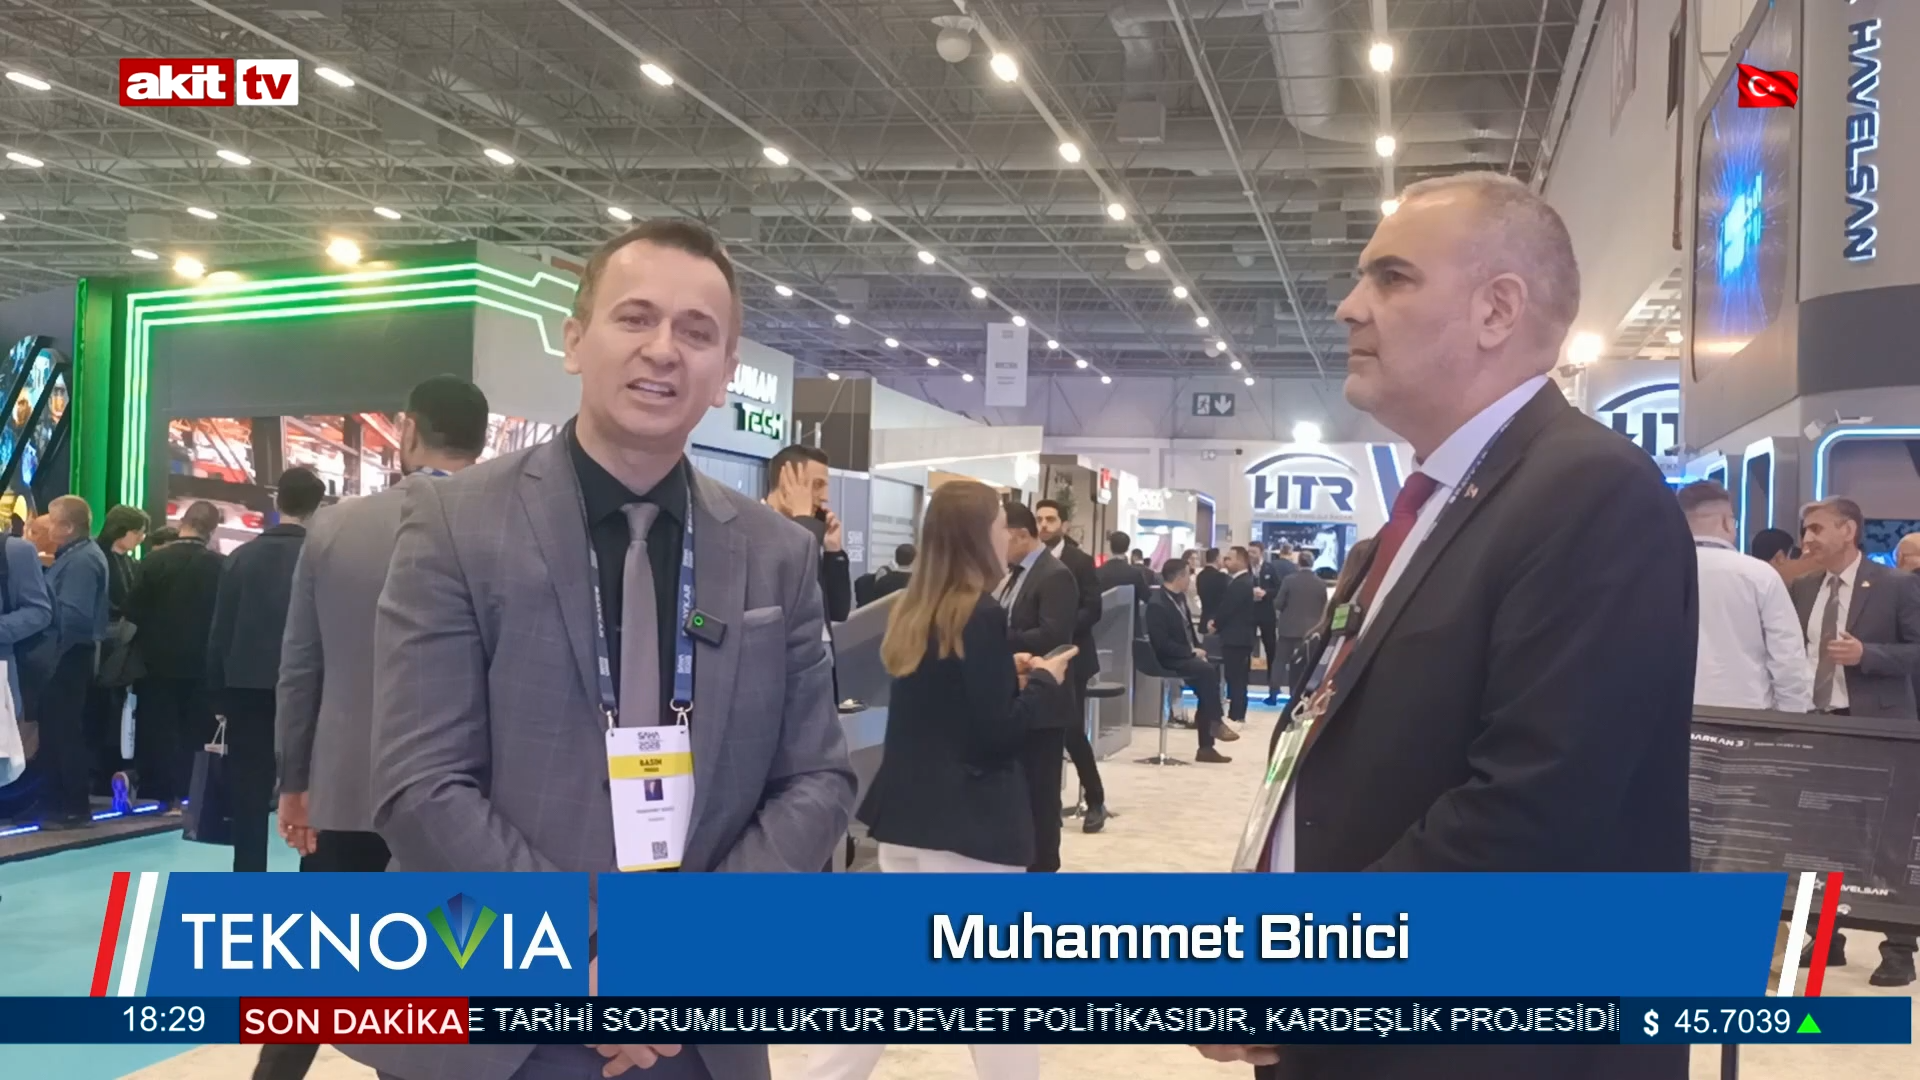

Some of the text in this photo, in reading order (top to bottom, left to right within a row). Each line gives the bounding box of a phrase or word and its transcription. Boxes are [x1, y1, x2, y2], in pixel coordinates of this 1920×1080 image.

[1843, 18, 1882, 261] HAVELSAN
[727, 363, 778, 405] UMAN
[1254, 475, 1354, 511] HTR
[1841, 884, 1889, 896] VELSAN
